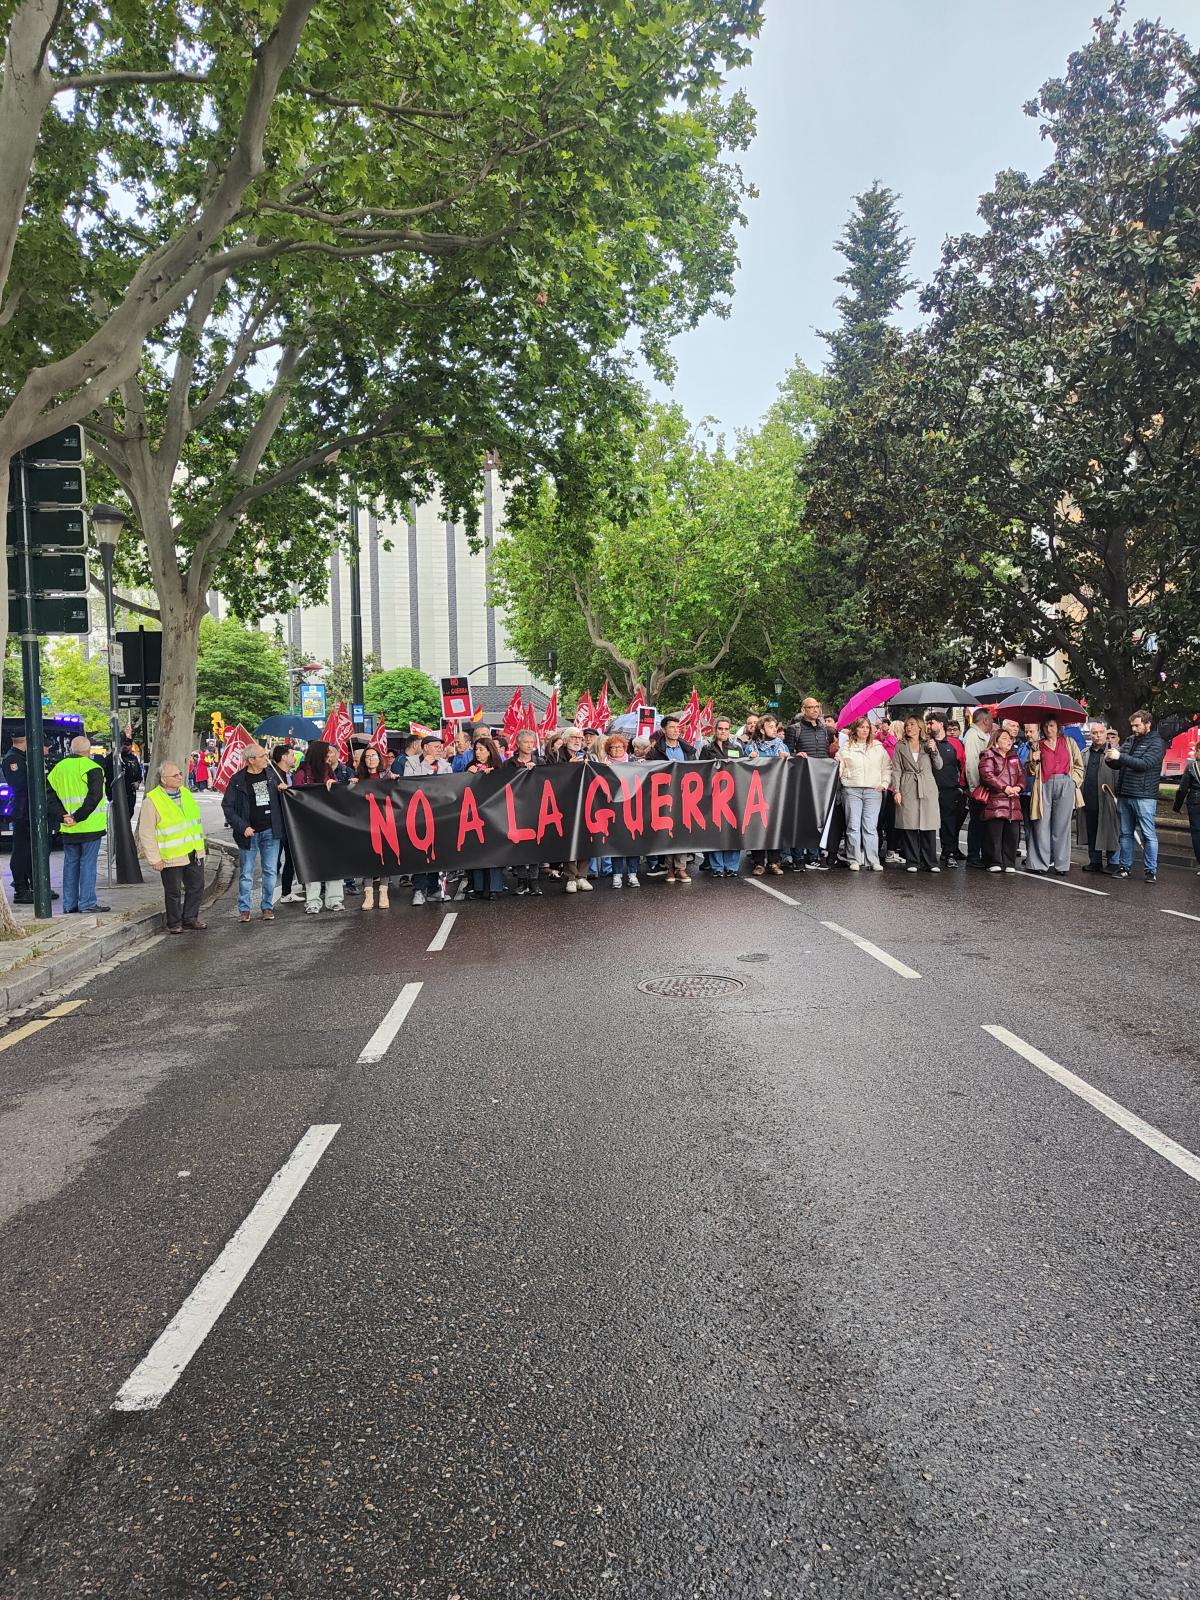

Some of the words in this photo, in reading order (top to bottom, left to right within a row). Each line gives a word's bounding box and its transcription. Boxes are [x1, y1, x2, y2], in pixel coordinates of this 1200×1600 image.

[366, 789, 435, 864] NO
[457, 786, 485, 851] A
[506, 780, 564, 845] LA
[584, 769, 769, 844] GUERRA
